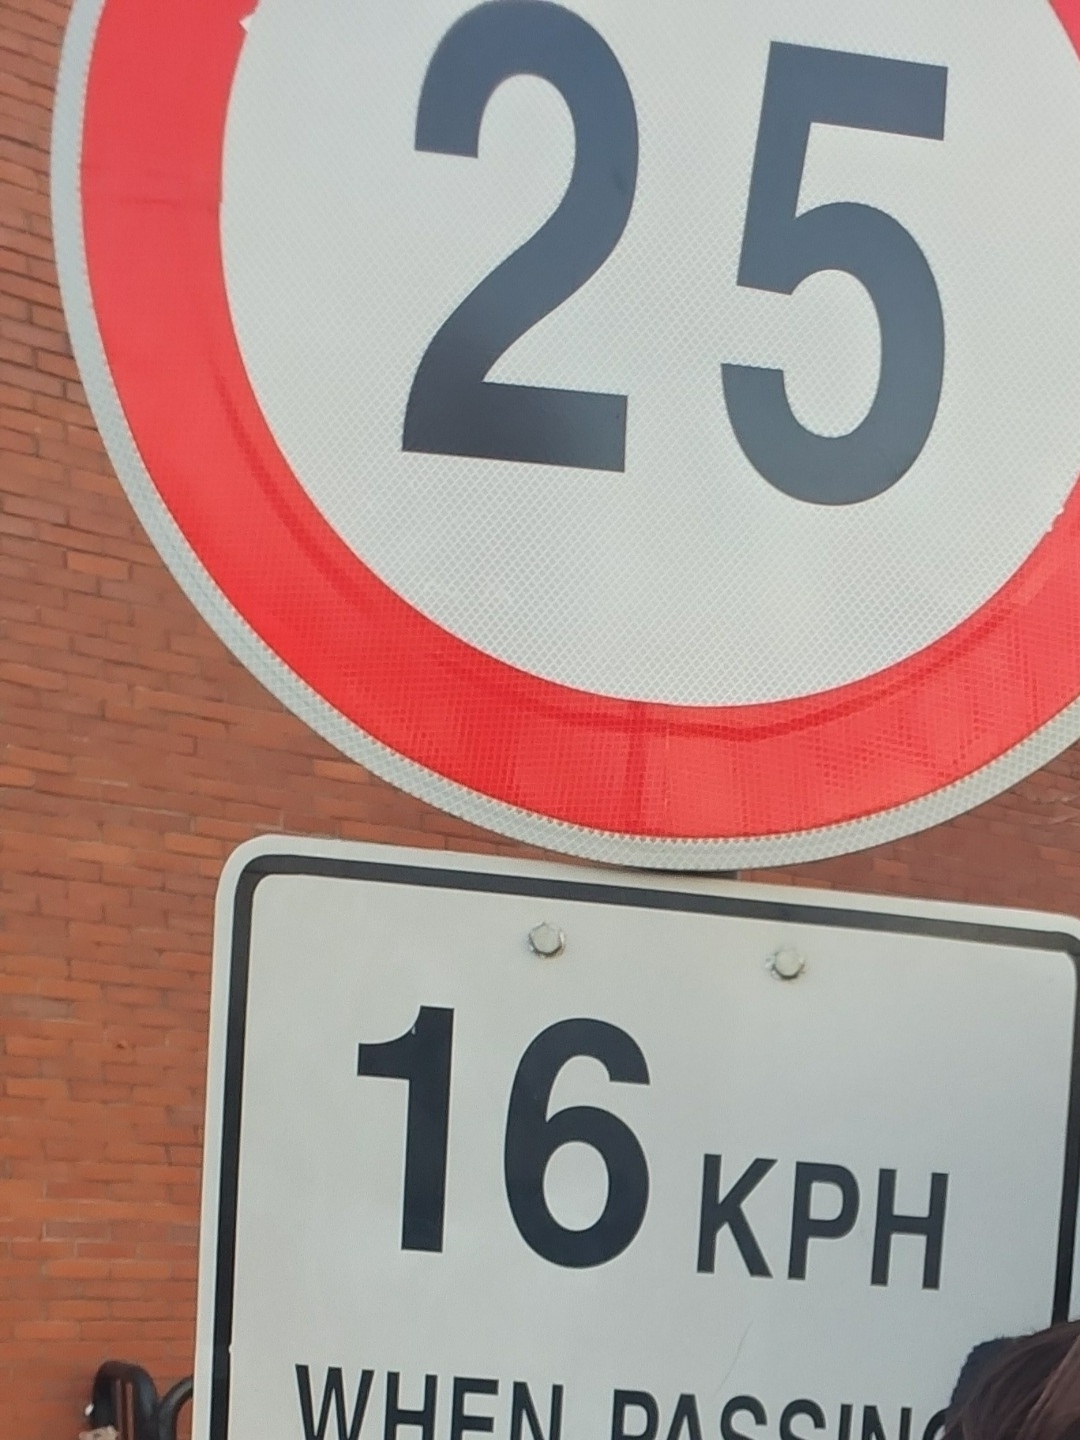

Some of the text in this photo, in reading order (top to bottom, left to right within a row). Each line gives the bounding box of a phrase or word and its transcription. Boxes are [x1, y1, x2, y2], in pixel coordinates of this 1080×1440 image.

[401, 0, 948, 506] 25
[356, 1005, 949, 1290] 16 KPH
